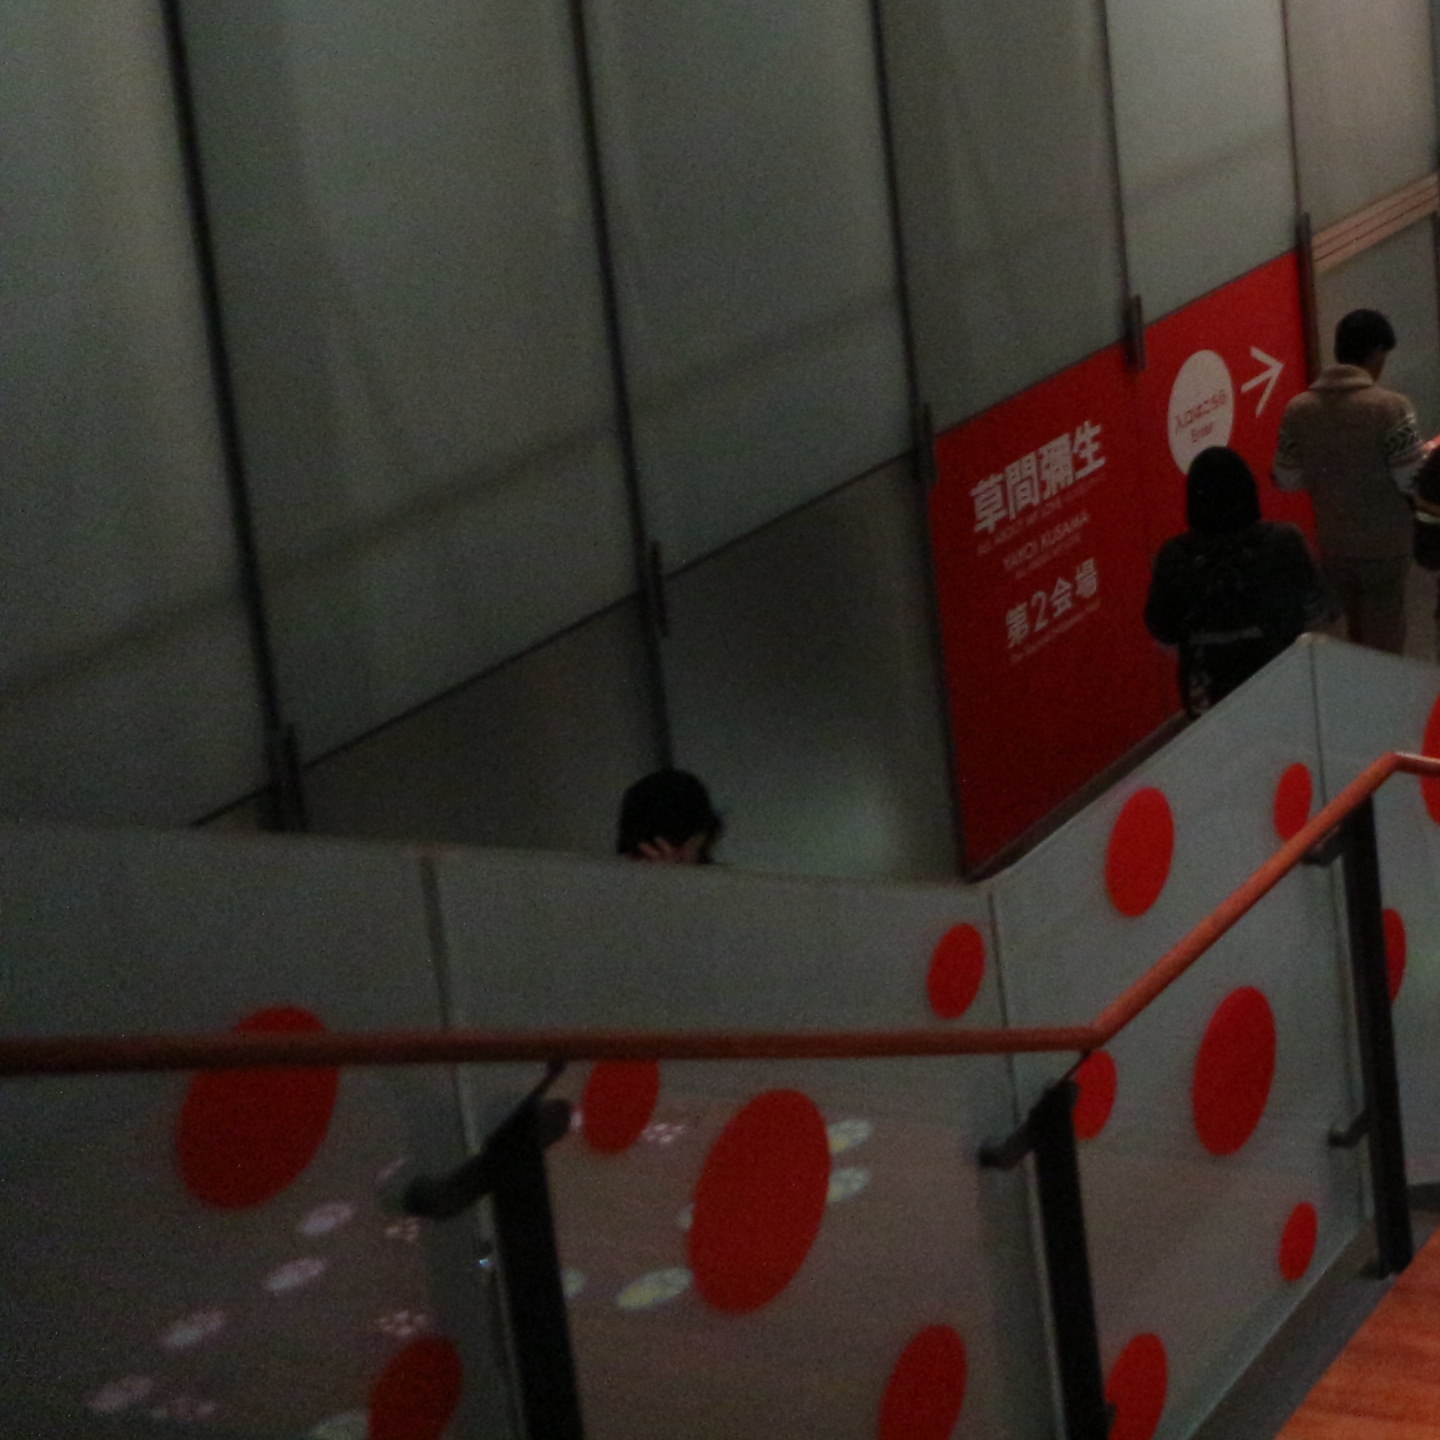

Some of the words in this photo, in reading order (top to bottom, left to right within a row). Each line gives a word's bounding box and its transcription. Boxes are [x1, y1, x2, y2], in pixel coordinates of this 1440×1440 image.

[970, 419, 1107, 534] 草間彌生
[1004, 555, 1100, 650] 第2会場
